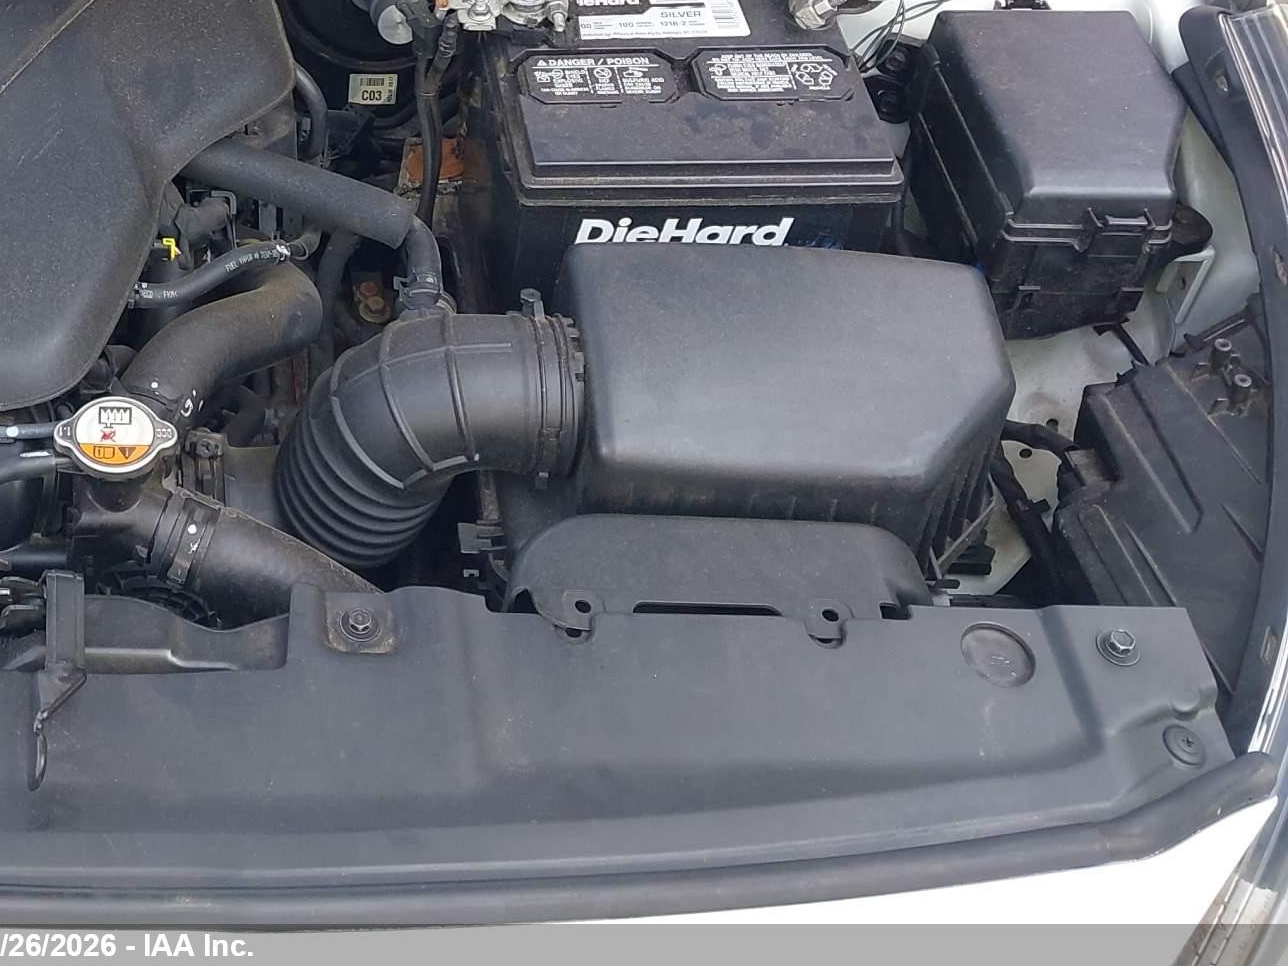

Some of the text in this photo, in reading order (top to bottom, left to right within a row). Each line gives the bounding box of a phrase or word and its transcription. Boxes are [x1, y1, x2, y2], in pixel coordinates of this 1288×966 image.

[660, 10, 701, 18] SILVER
[606, 57, 649, 65] POISON
[361, 90, 382, 101] C03
[574, 217, 794, 246] DieHard
